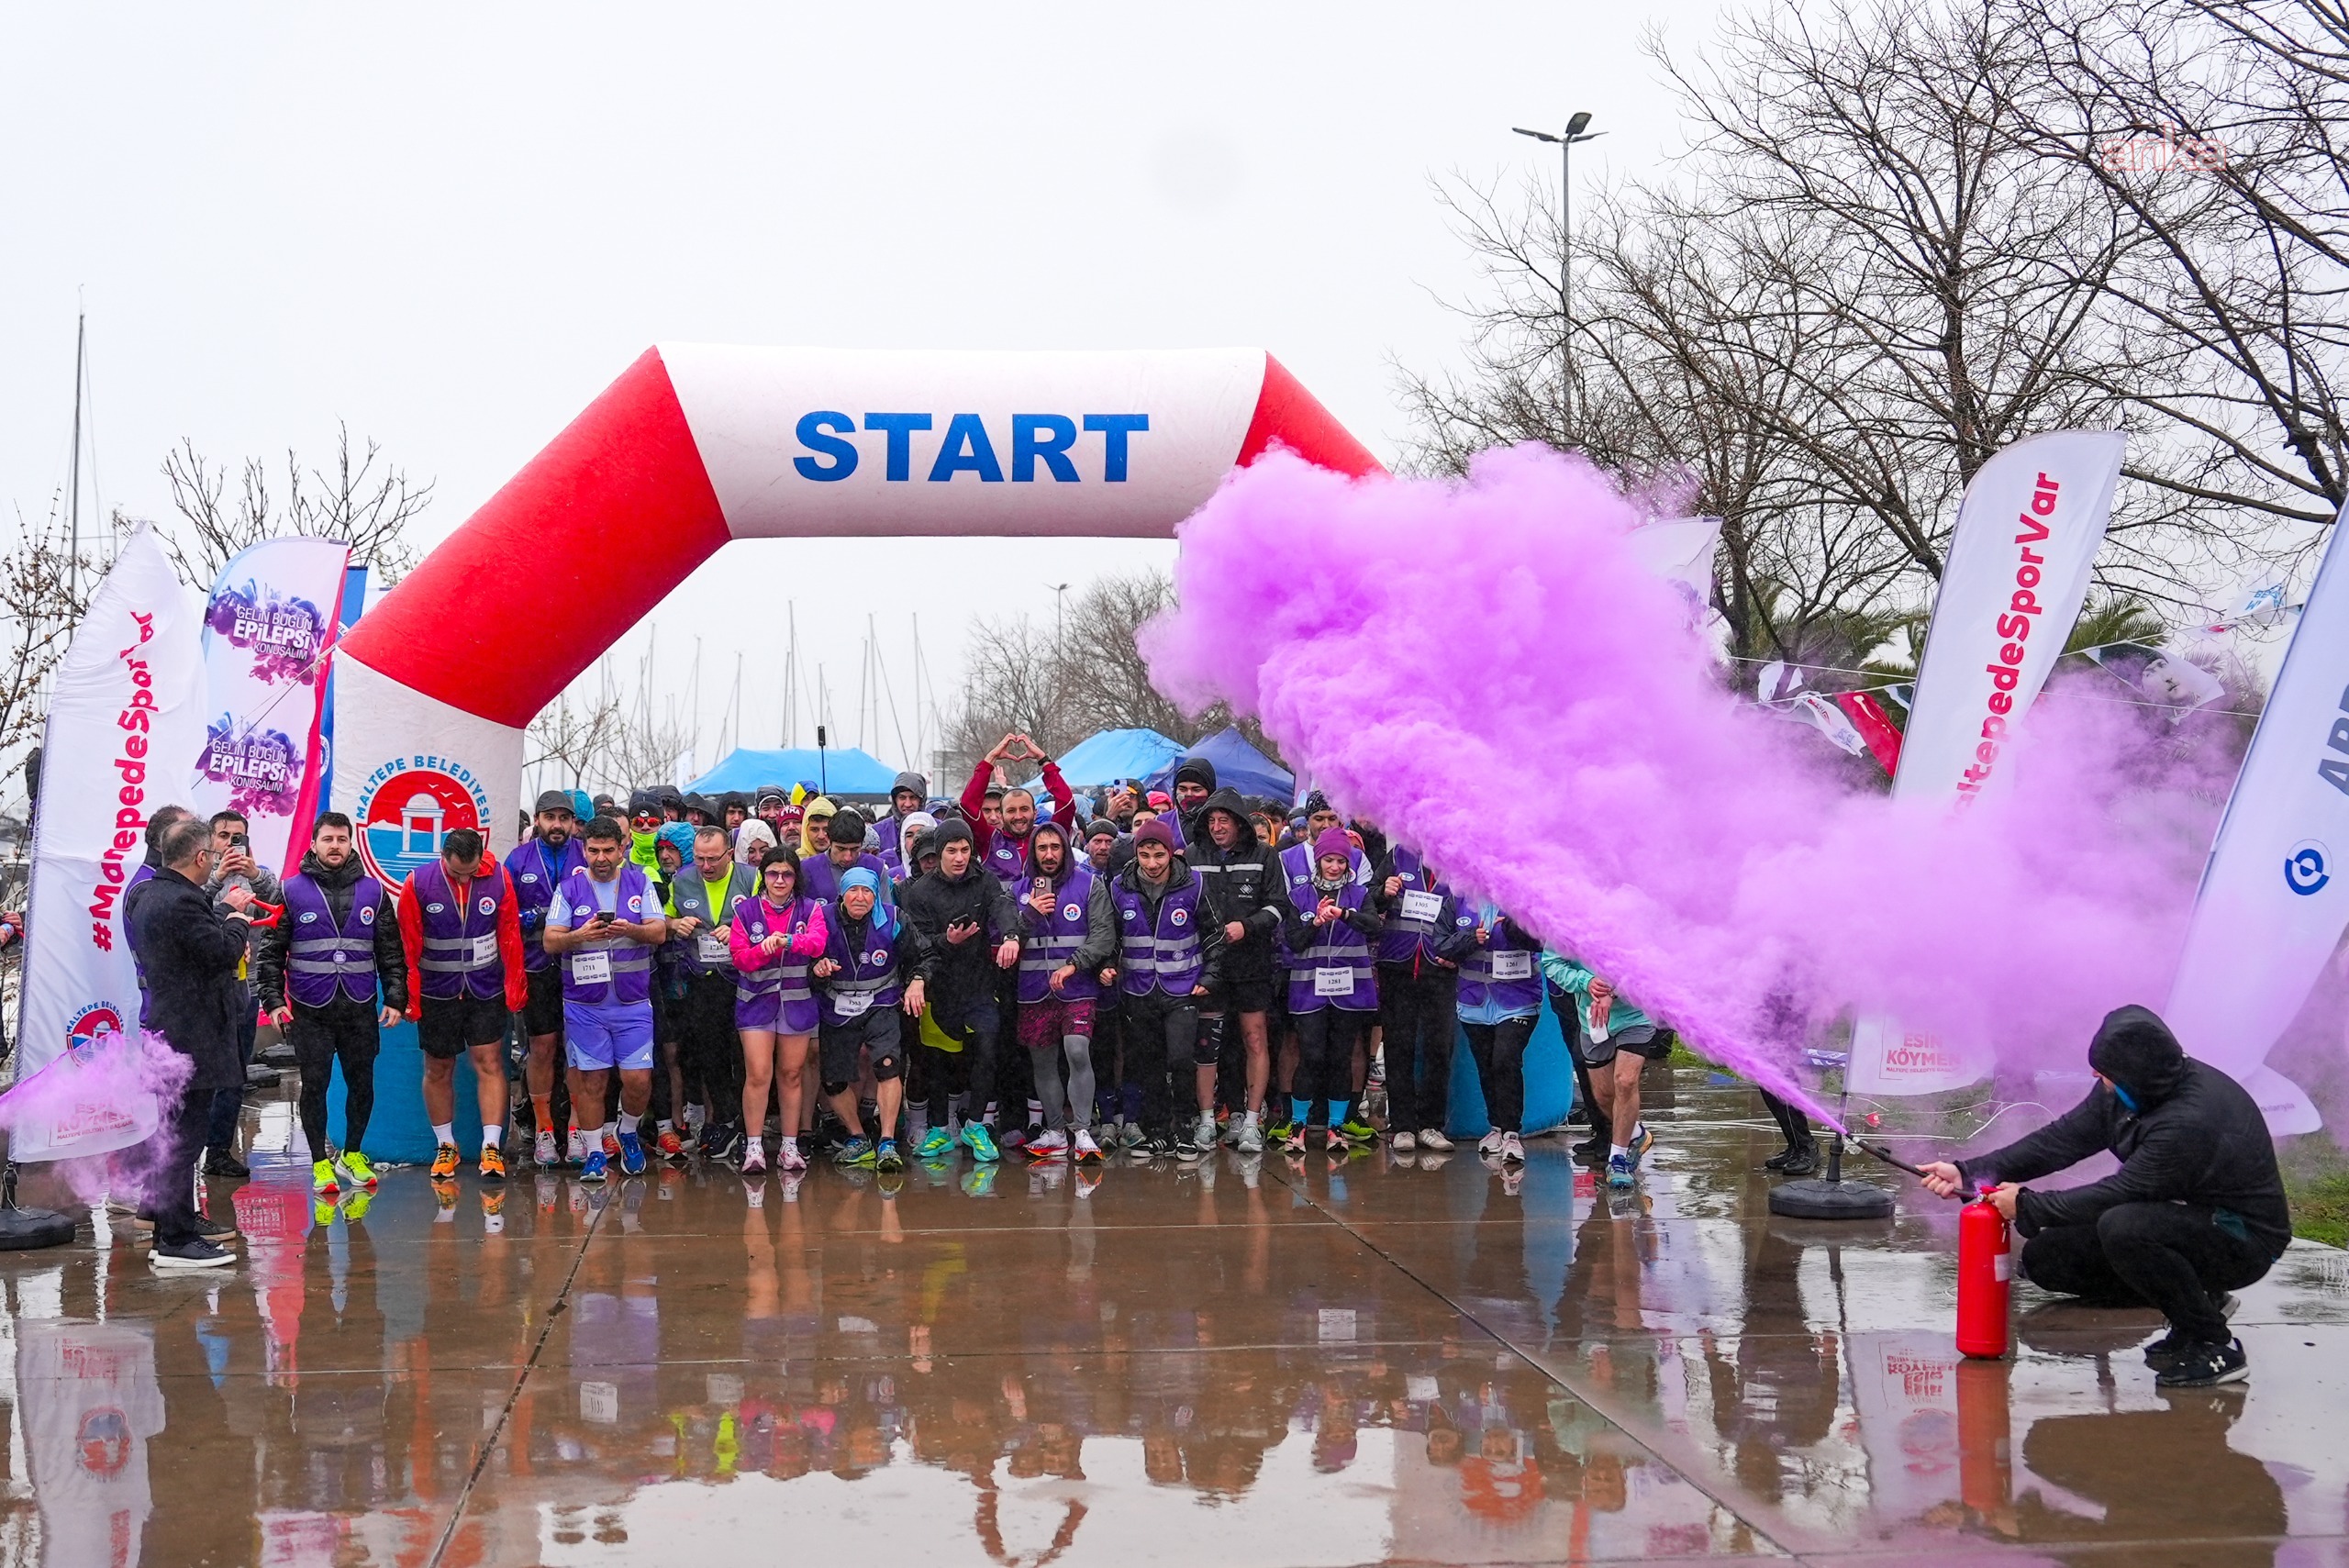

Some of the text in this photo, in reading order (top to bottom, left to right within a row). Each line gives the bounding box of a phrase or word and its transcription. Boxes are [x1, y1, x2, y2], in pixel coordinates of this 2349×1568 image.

[794, 411, 1149, 482] START
[273, 613, 313, 630] BUGÜN
[252, 642, 308, 660] KONUŞALIM
[1947, 473, 2060, 819] altepedeSporVar
[248, 746, 287, 763] BUGÜN
[229, 776, 284, 793] KONUŞALIM
[356, 755, 491, 824] MALTEPE BELEDİYESİ
[66, 1002, 99, 1032] MALTEPE
